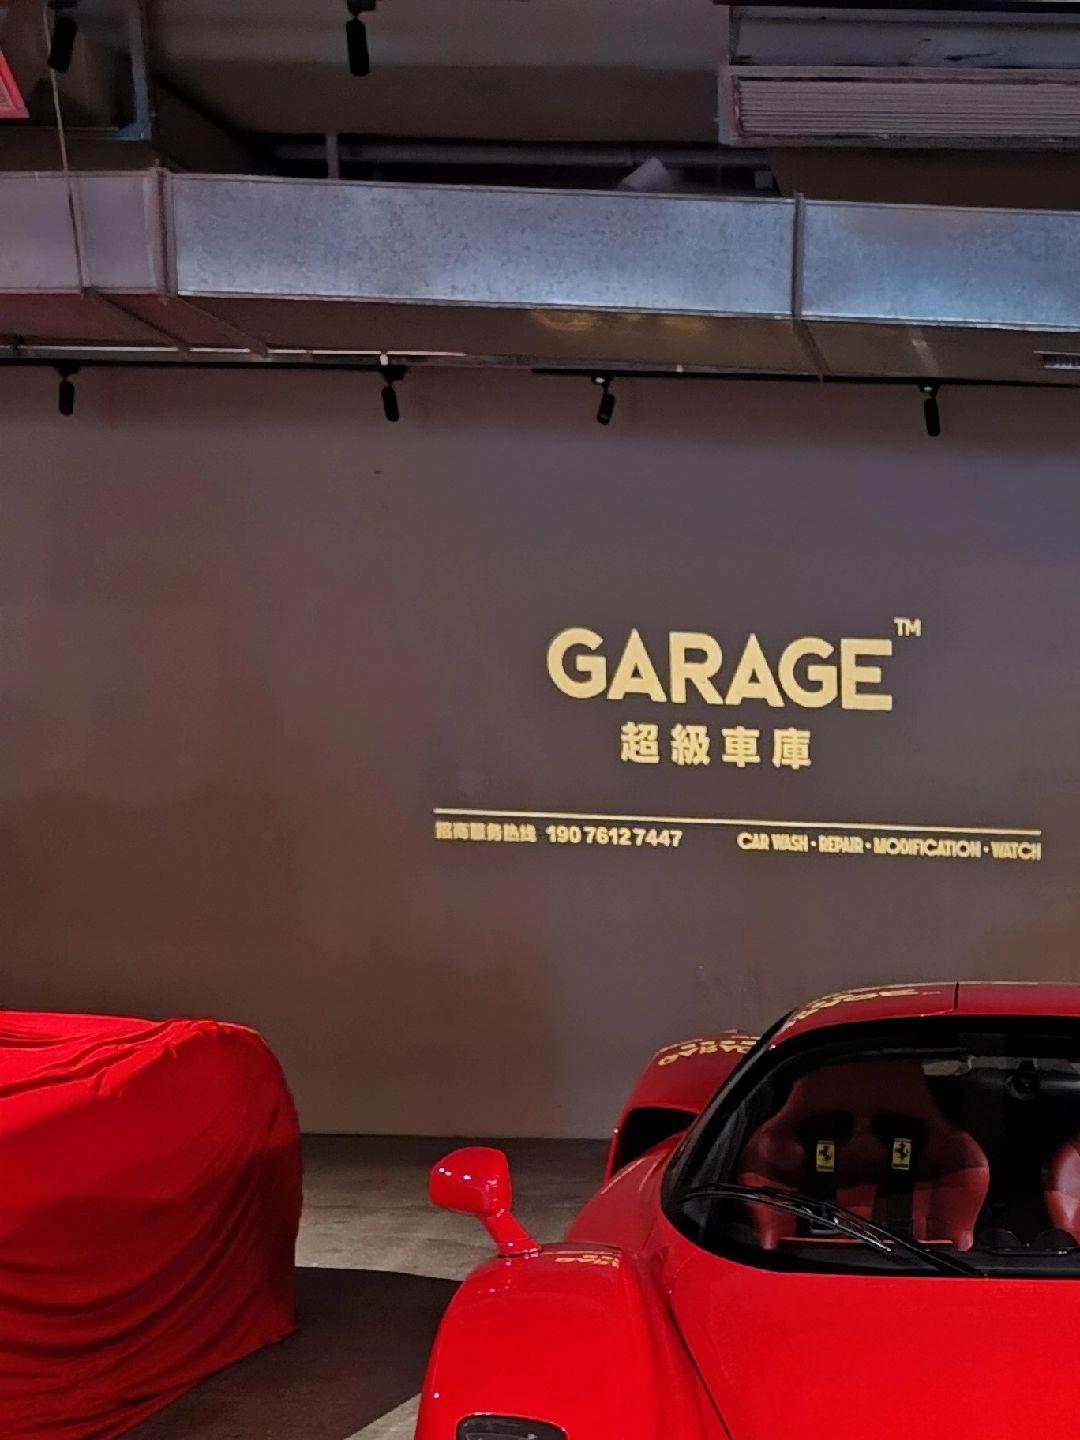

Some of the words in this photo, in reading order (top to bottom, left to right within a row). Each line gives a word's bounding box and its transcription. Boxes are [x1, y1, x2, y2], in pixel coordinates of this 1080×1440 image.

[547, 628, 892, 710] GARAGE
[621, 722, 811, 769] 超級車庫
[737, 832, 769, 850] CAR
[771, 834, 808, 852] WASH
[819, 835, 864, 853] REPAIR
[873, 837, 981, 857] MODIFICATION
[991, 842, 1041, 860] WATCH
